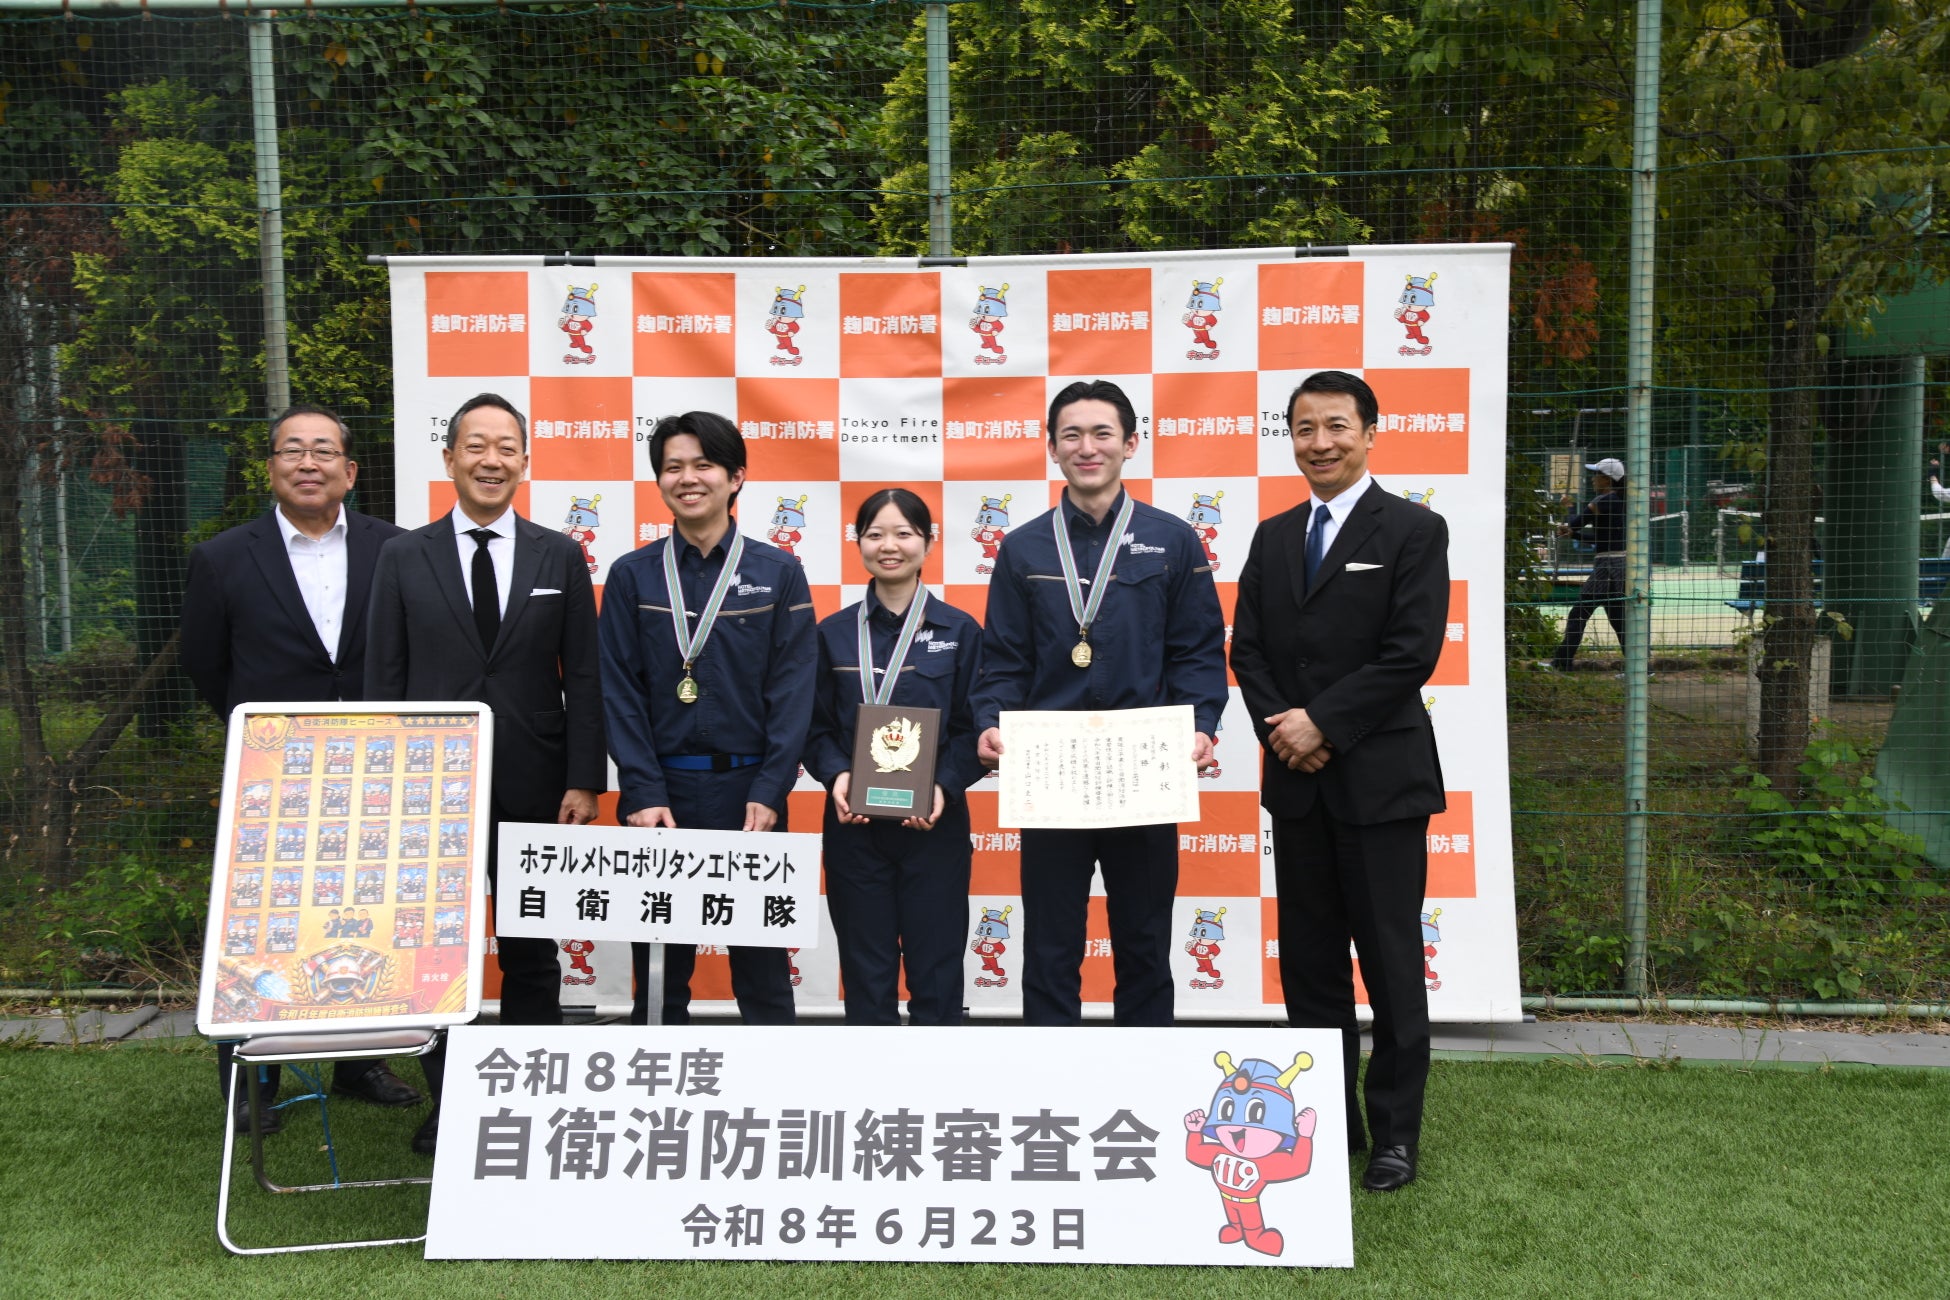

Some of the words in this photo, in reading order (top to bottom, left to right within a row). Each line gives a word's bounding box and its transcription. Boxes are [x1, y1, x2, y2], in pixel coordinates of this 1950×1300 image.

[431, 314, 526, 333] 麹町消防署
[637, 315, 732, 333] 麹町消防署
[1053, 311, 1149, 331] 麹町消防署
[1263, 304, 1360, 325] 麹町消防署
[843, 315, 937, 334] 麹町消防署
[841, 418, 889, 428] Tokyo
[900, 417, 939, 427] Fire
[1261, 411, 1290, 421] Tok
[534, 420, 630, 439] 麹町消防署
[741, 421, 836, 440] 麹町消防署
[946, 420, 1041, 439] 麹町消防署
[1157, 416, 1254, 437] 麹町消防署
[841, 433, 938, 443] Department
[975, 564, 992, 575] キュ
[1197, 769, 1221, 778] ュータ
[970, 832, 1021, 852] 町消防
[1179, 834, 1257, 853] 町消防署
[520, 843, 796, 884] ホテルメトロポリタンエドモント
[519, 886, 797, 928] 自衛消防隊
[475, 1047, 724, 1097] 令和8年度
[474, 1108, 1160, 1182] 自衛消防訓練審査会
[1213, 1155, 1259, 1191] 119
[681, 1204, 1085, 1250] 令和8年6月23日
